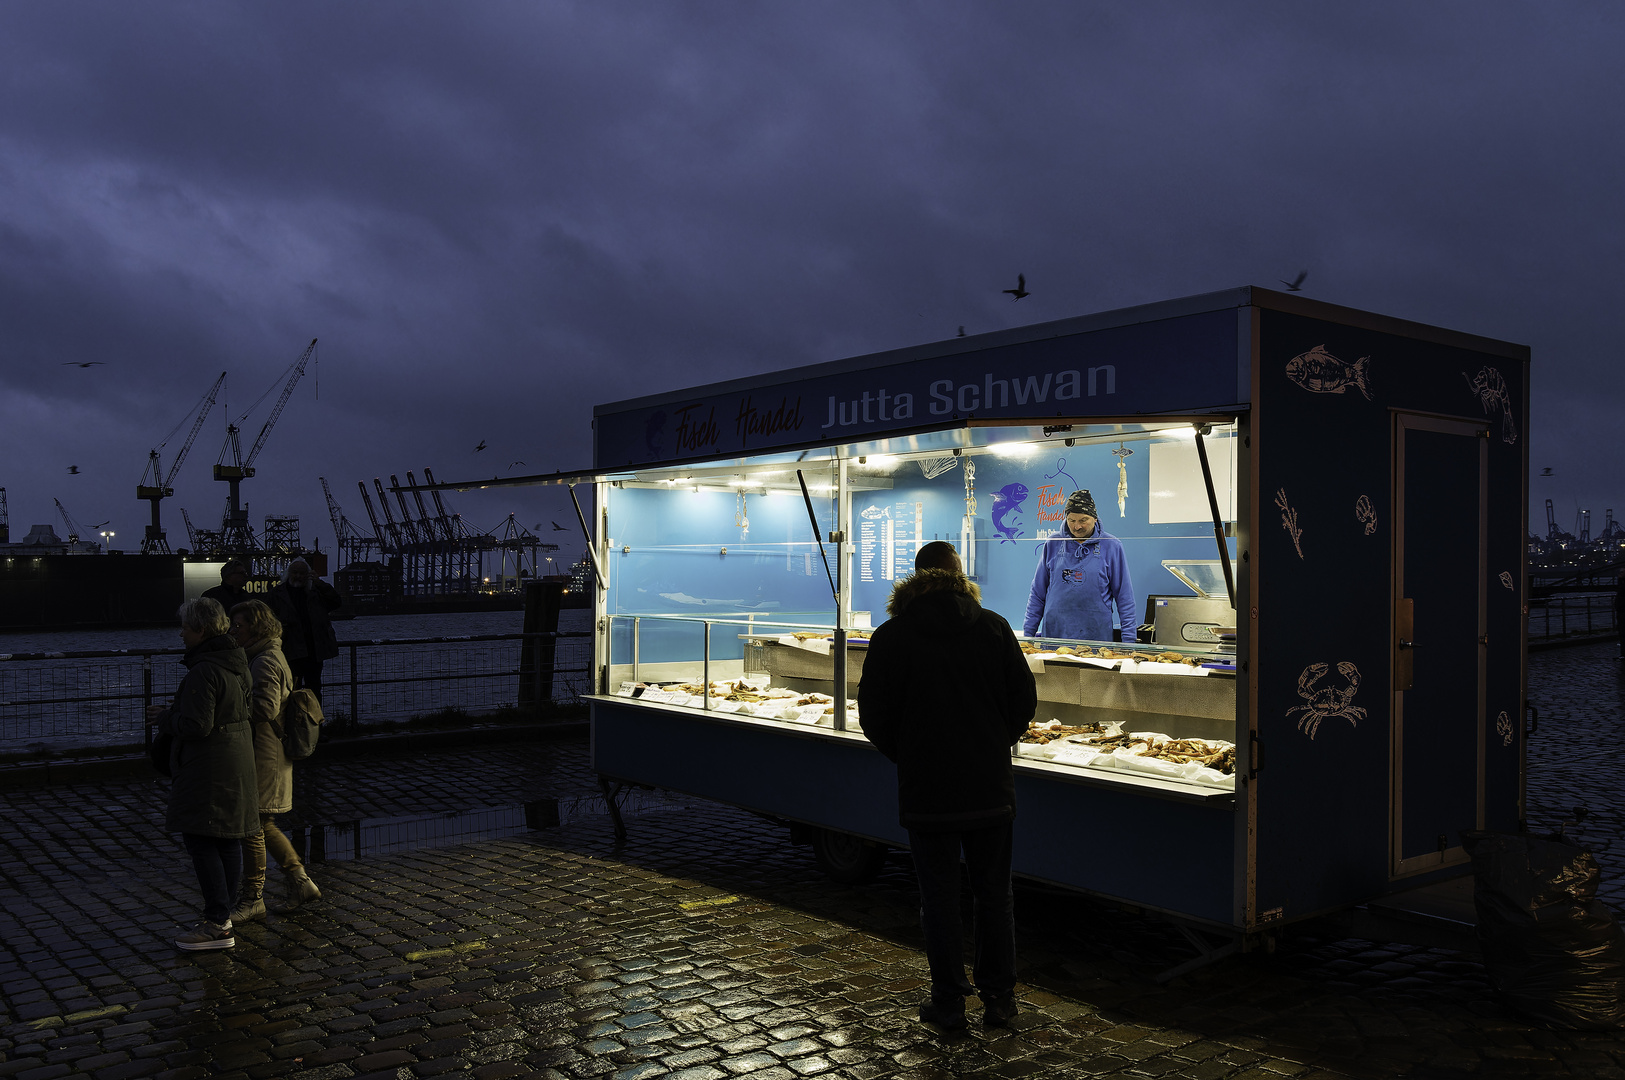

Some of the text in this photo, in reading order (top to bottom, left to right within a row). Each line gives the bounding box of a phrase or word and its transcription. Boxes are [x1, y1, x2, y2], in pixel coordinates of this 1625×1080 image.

[822, 363, 1116, 429] Jutta Schwan
[674, 397, 804, 455] Fisch Handel
[1036, 485, 1067, 508] Fisch
[1036, 507, 1065, 525] Handel
[242, 580, 268, 593] OCK
